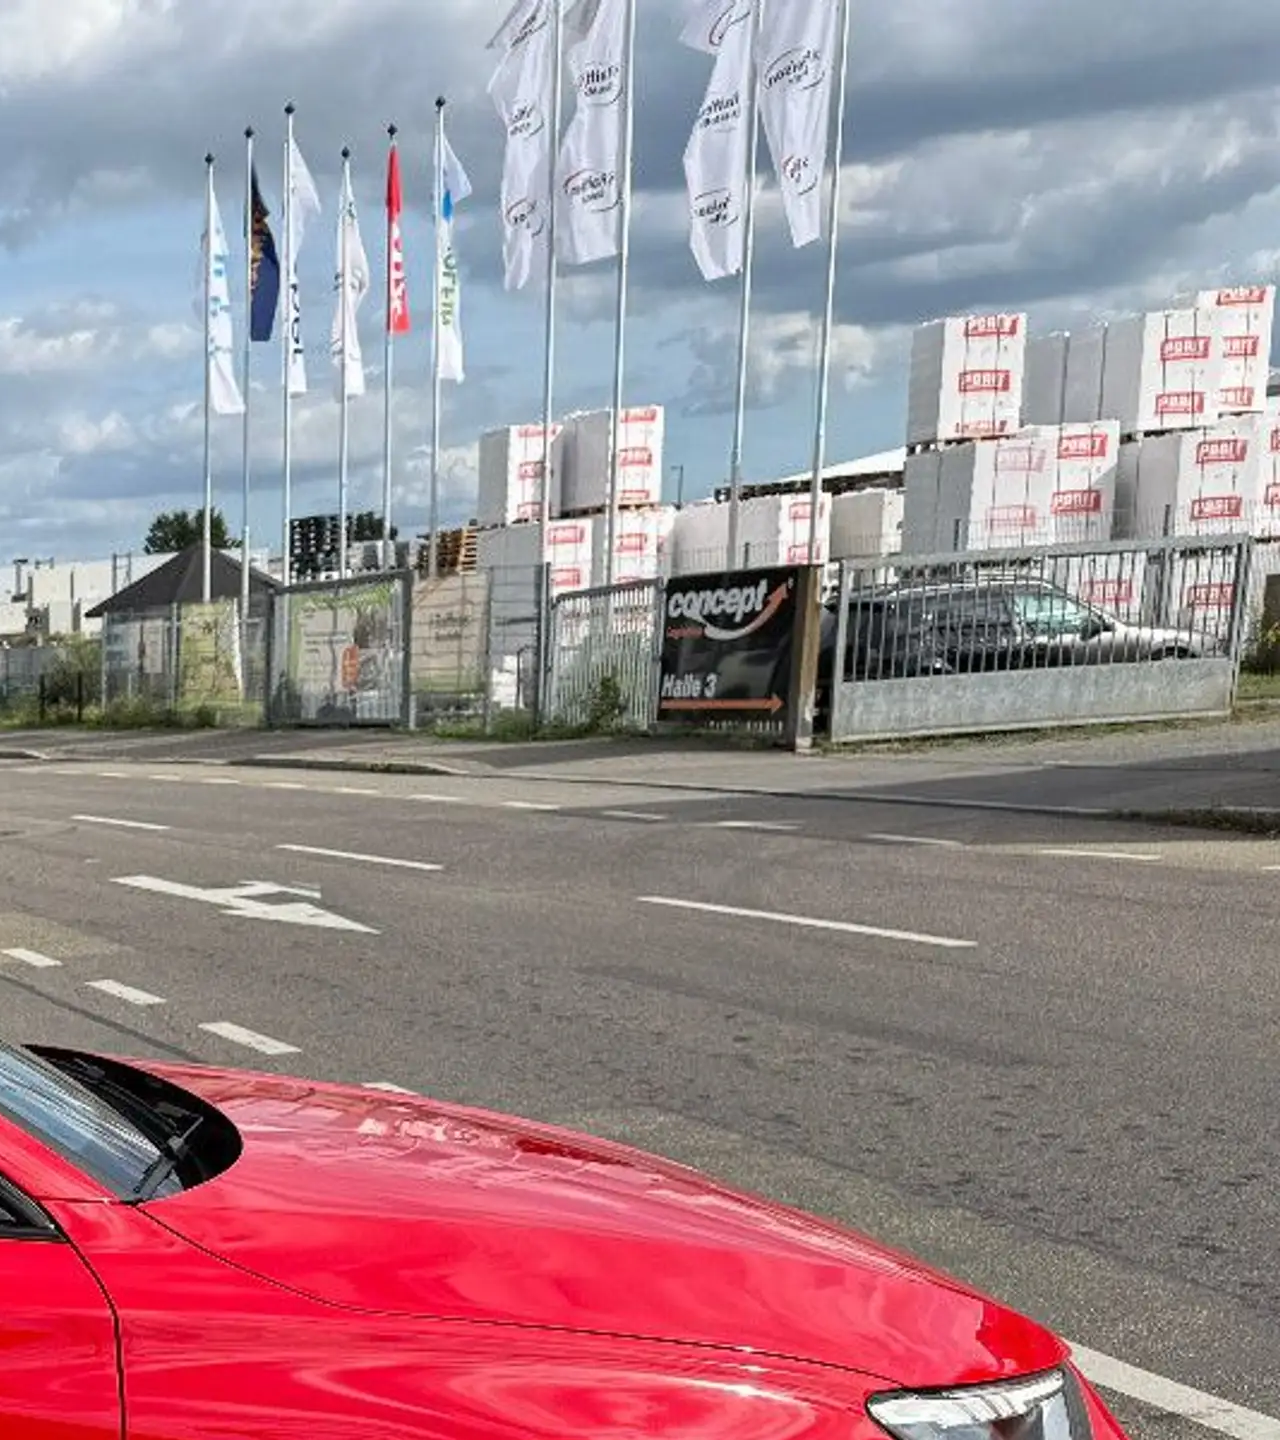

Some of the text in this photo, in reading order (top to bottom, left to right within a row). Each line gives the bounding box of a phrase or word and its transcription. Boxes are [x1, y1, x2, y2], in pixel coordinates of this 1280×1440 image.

[668, 578, 768, 622] concept
[661, 673, 717, 697] Halle 3
